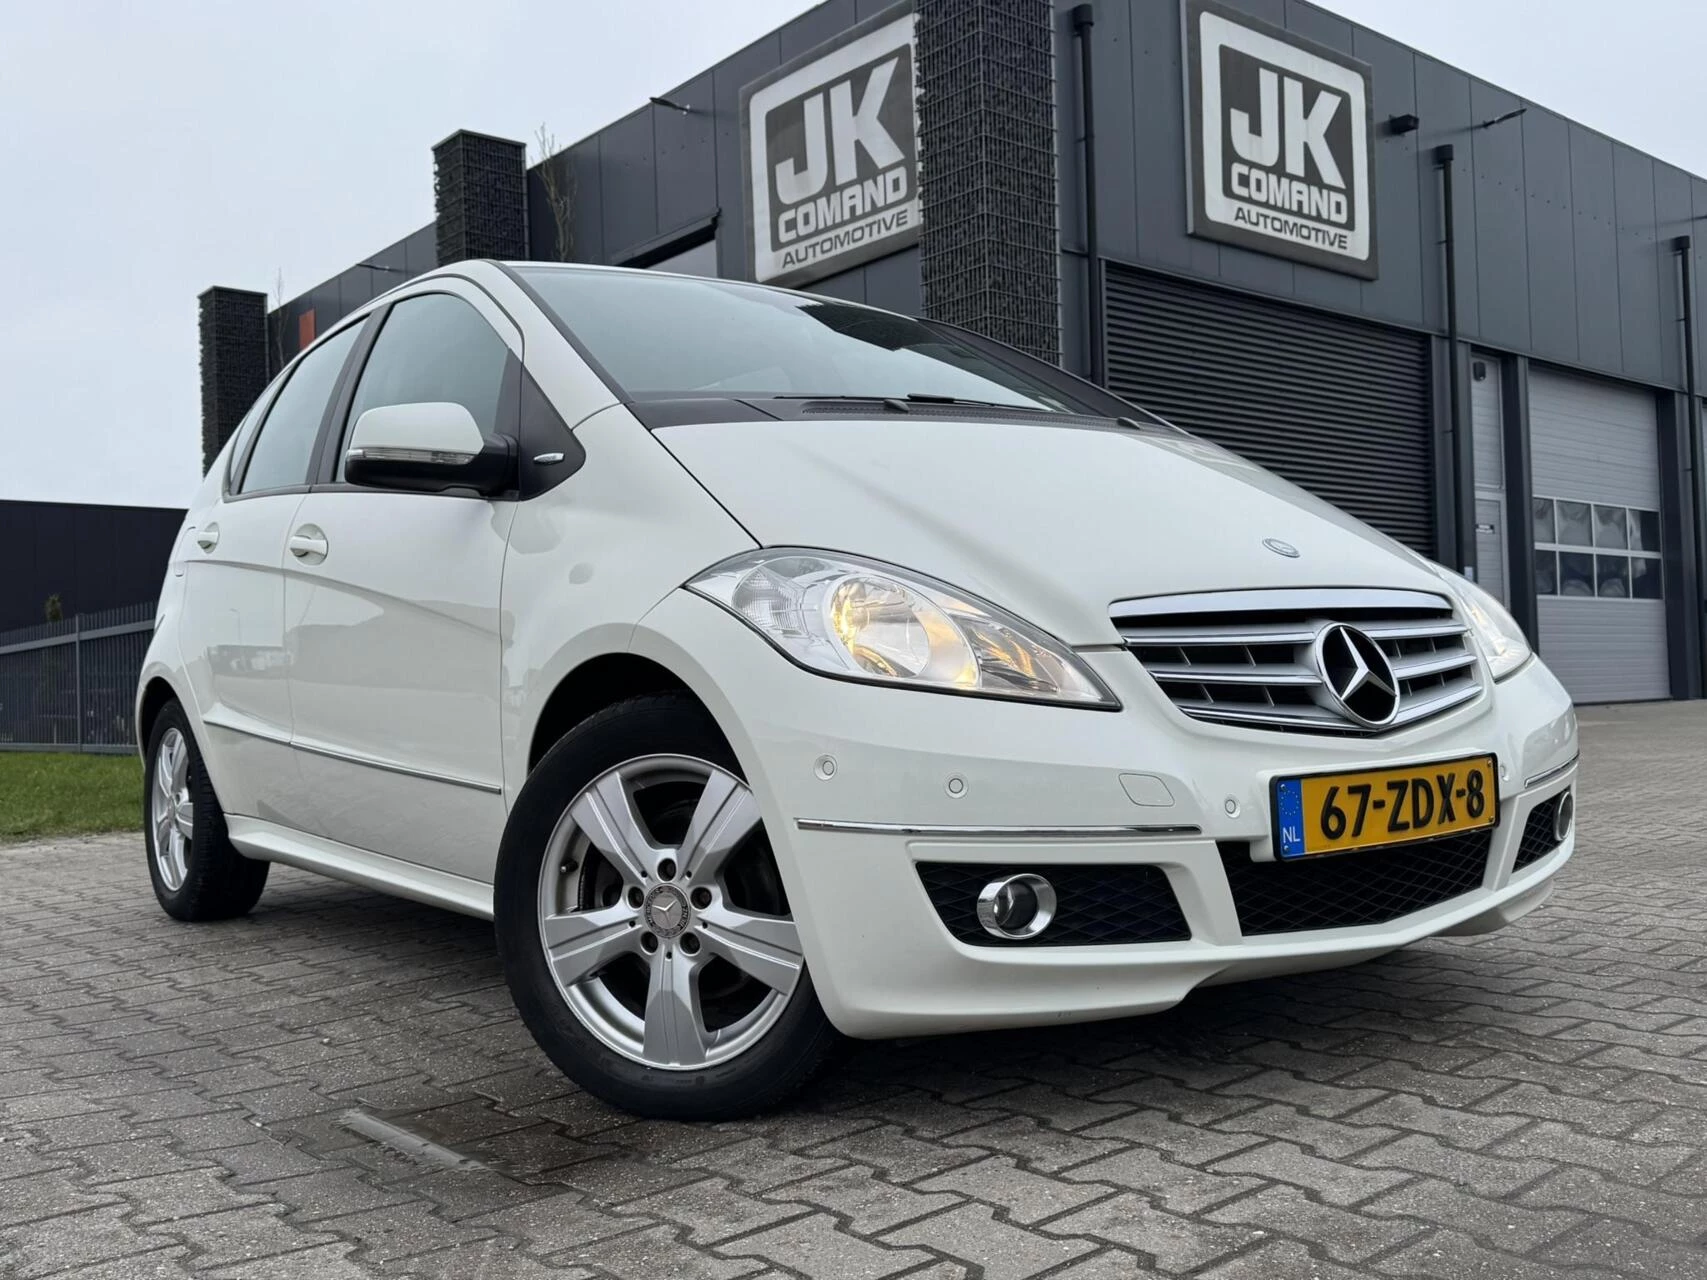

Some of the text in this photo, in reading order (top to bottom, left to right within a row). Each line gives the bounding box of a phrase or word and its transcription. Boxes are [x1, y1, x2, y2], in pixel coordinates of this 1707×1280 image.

[775, 56, 905, 206] JK
[1230, 67, 1346, 189] JK
[778, 165, 907, 244] COMAND
[1231, 162, 1348, 224] COMAND
[782, 209, 908, 269] AUTOMOTIVE
[1234, 206, 1348, 250] AUTOMOTIVE
[1282, 826, 1301, 844] NL
[1320, 769, 1485, 841] 67-ZDX-8
